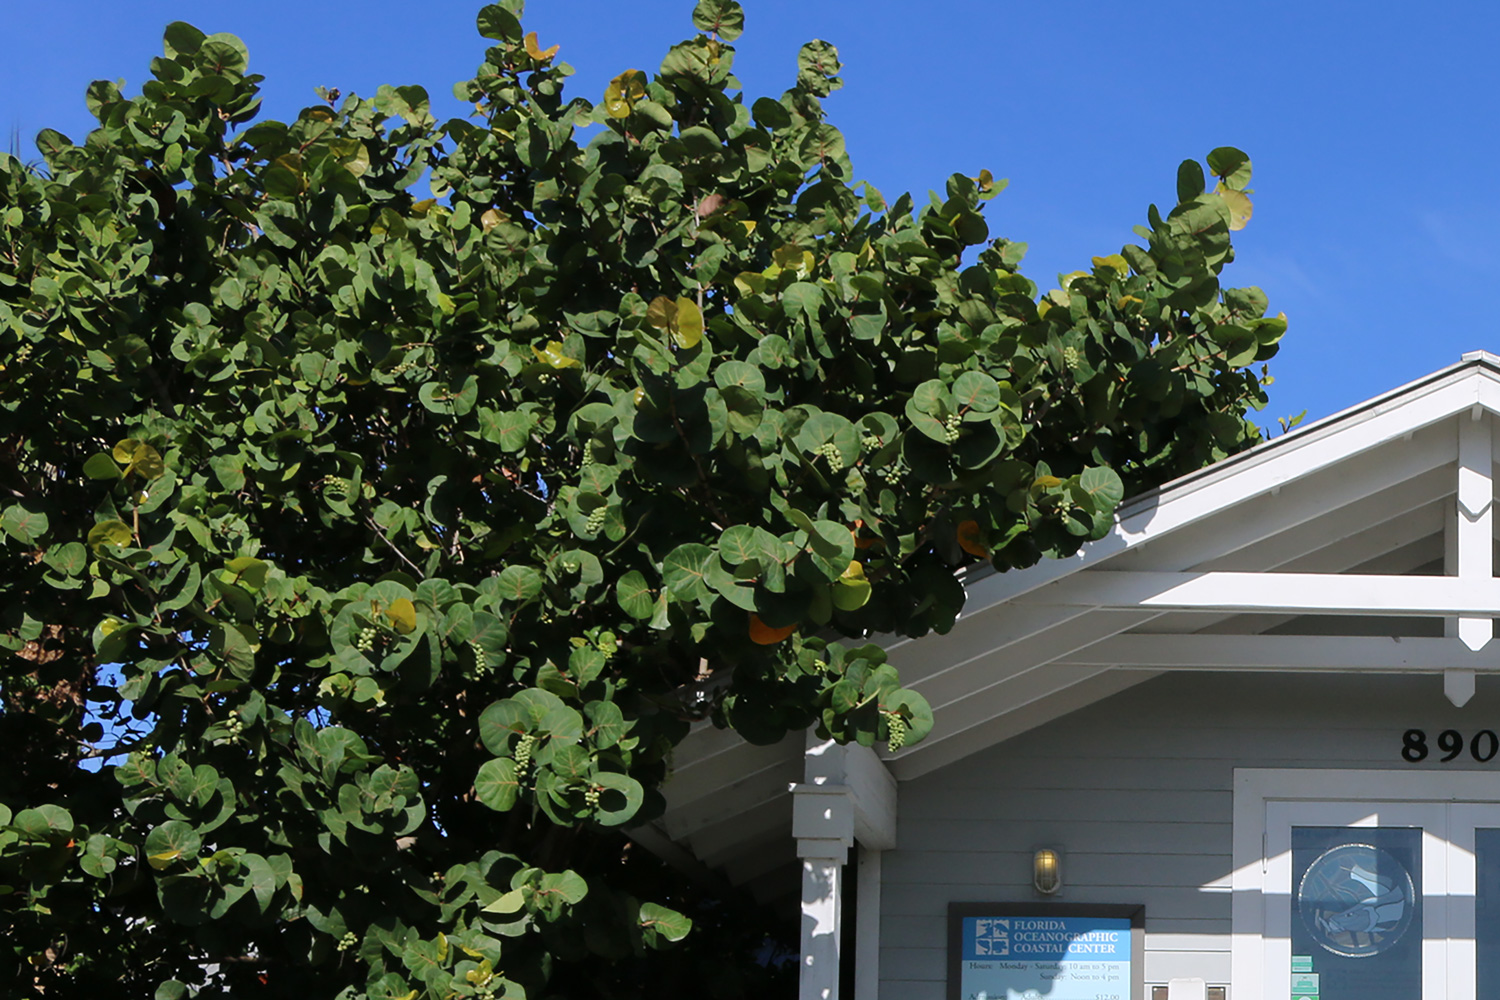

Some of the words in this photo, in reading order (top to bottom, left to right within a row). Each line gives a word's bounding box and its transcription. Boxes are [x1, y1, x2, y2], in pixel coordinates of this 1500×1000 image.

[1401, 729, 1499, 763] 890
[1014, 921, 1066, 930] FLORIDA
[1014, 932, 1118, 942] OCEANOGRAPHIC
[1014, 943, 1064, 953] COASTAL
[1068, 944, 1116, 954] CENTER
[1000, 962, 1028, 971] Monday
[1108, 964, 1120, 972] pm
[1070, 973, 1090, 981] Noon
[1108, 975, 1120, 983] pm
